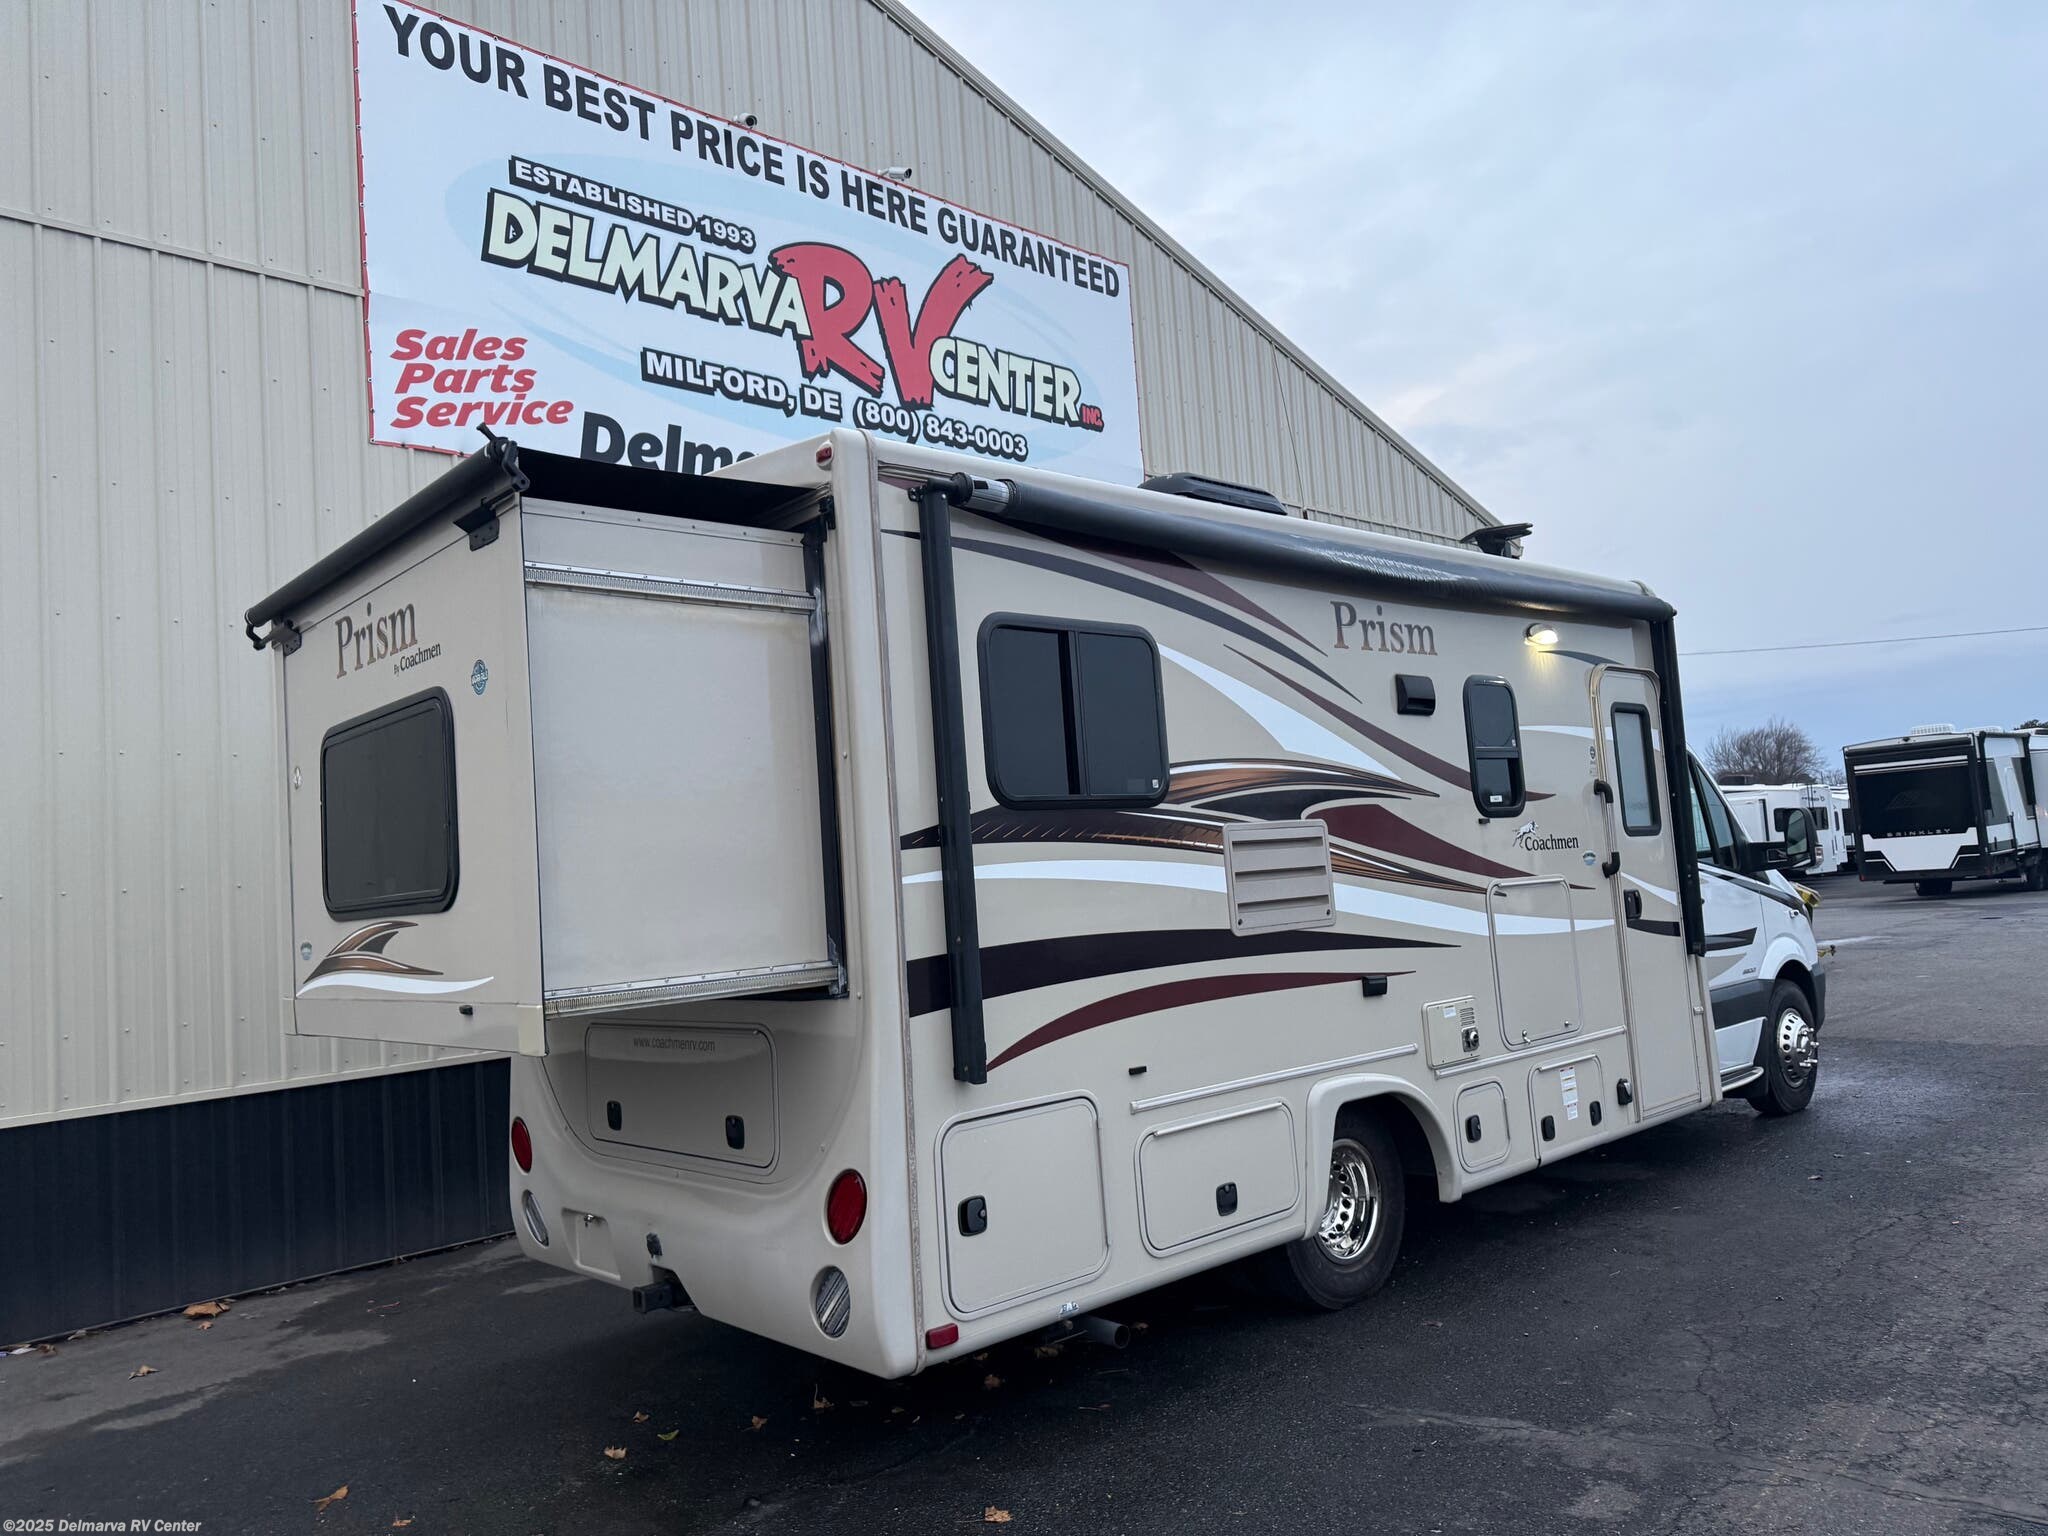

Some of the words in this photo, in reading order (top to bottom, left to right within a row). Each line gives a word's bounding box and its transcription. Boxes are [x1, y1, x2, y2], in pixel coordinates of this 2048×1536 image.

[382, 4, 529, 98] YOUR
[543, 62, 655, 141] BEST
[670, 110, 786, 186] PRICE
[796, 154, 830, 200] IS
[841, 170, 928, 235] HERE
[937, 206, 1120, 298] GUARANTEED
[511, 158, 696, 231] ESTABLISHED
[699, 216, 757, 251] 1993
[484, 190, 814, 337] DELMARVA
[768, 241, 994, 412] RV
[929, 335, 1081, 424] CENTER
[390, 328, 528, 362] Sales
[394, 363, 537, 395] Parts
[645, 350, 797, 411] MILFORD,
[803, 386, 841, 416] DE
[856, 400, 920, 438] (800)
[925, 417, 1028, 456] 843-0003
[390, 395, 574, 428] Service
[580, 411, 758, 475] Delm
[335, 602, 418, 679] Prism
[400, 642, 441, 671] Coachmen
[1330, 600, 1438, 656] Prism
[1524, 835, 1579, 851] Coachmen
